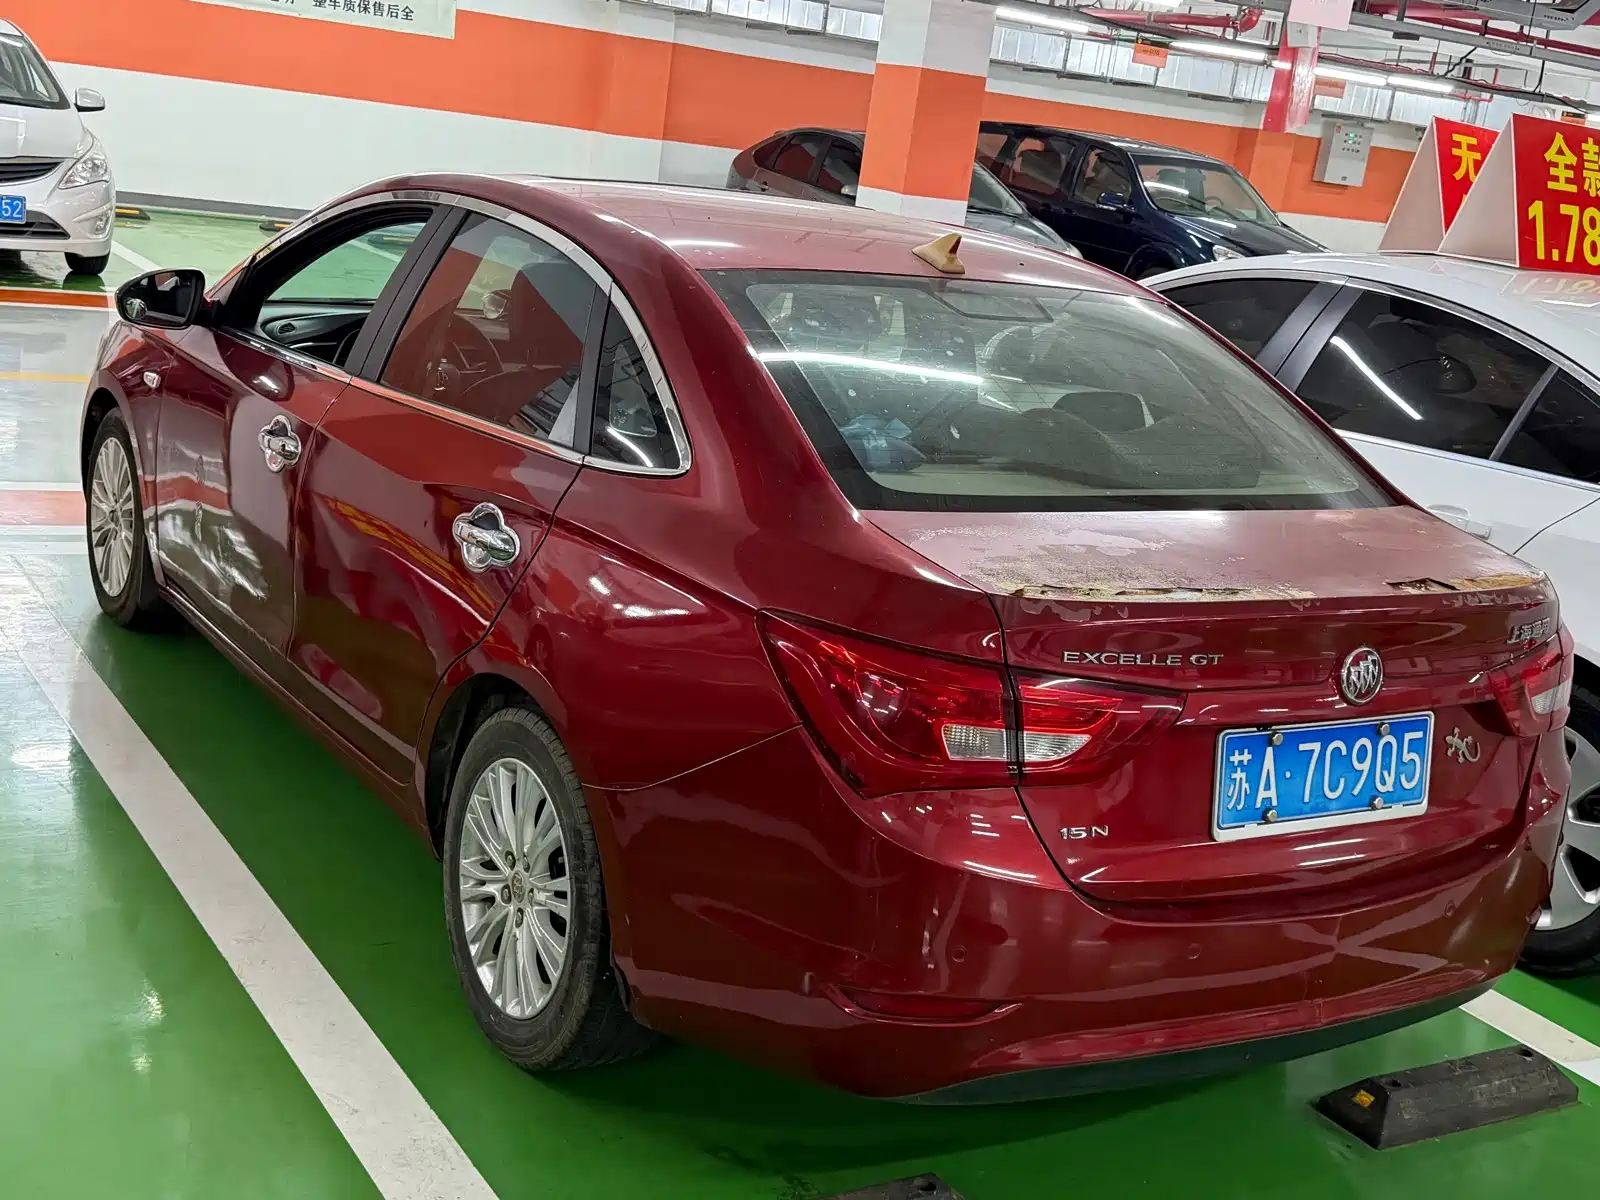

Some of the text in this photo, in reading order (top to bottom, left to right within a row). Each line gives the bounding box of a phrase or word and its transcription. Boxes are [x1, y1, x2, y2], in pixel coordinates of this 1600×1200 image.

[1451, 133, 1482, 183] 无
[2, 199, 22, 218] 52
[1528, 200, 1600, 266] 1.78
[1063, 650, 1224, 666] EXCELLE GT
